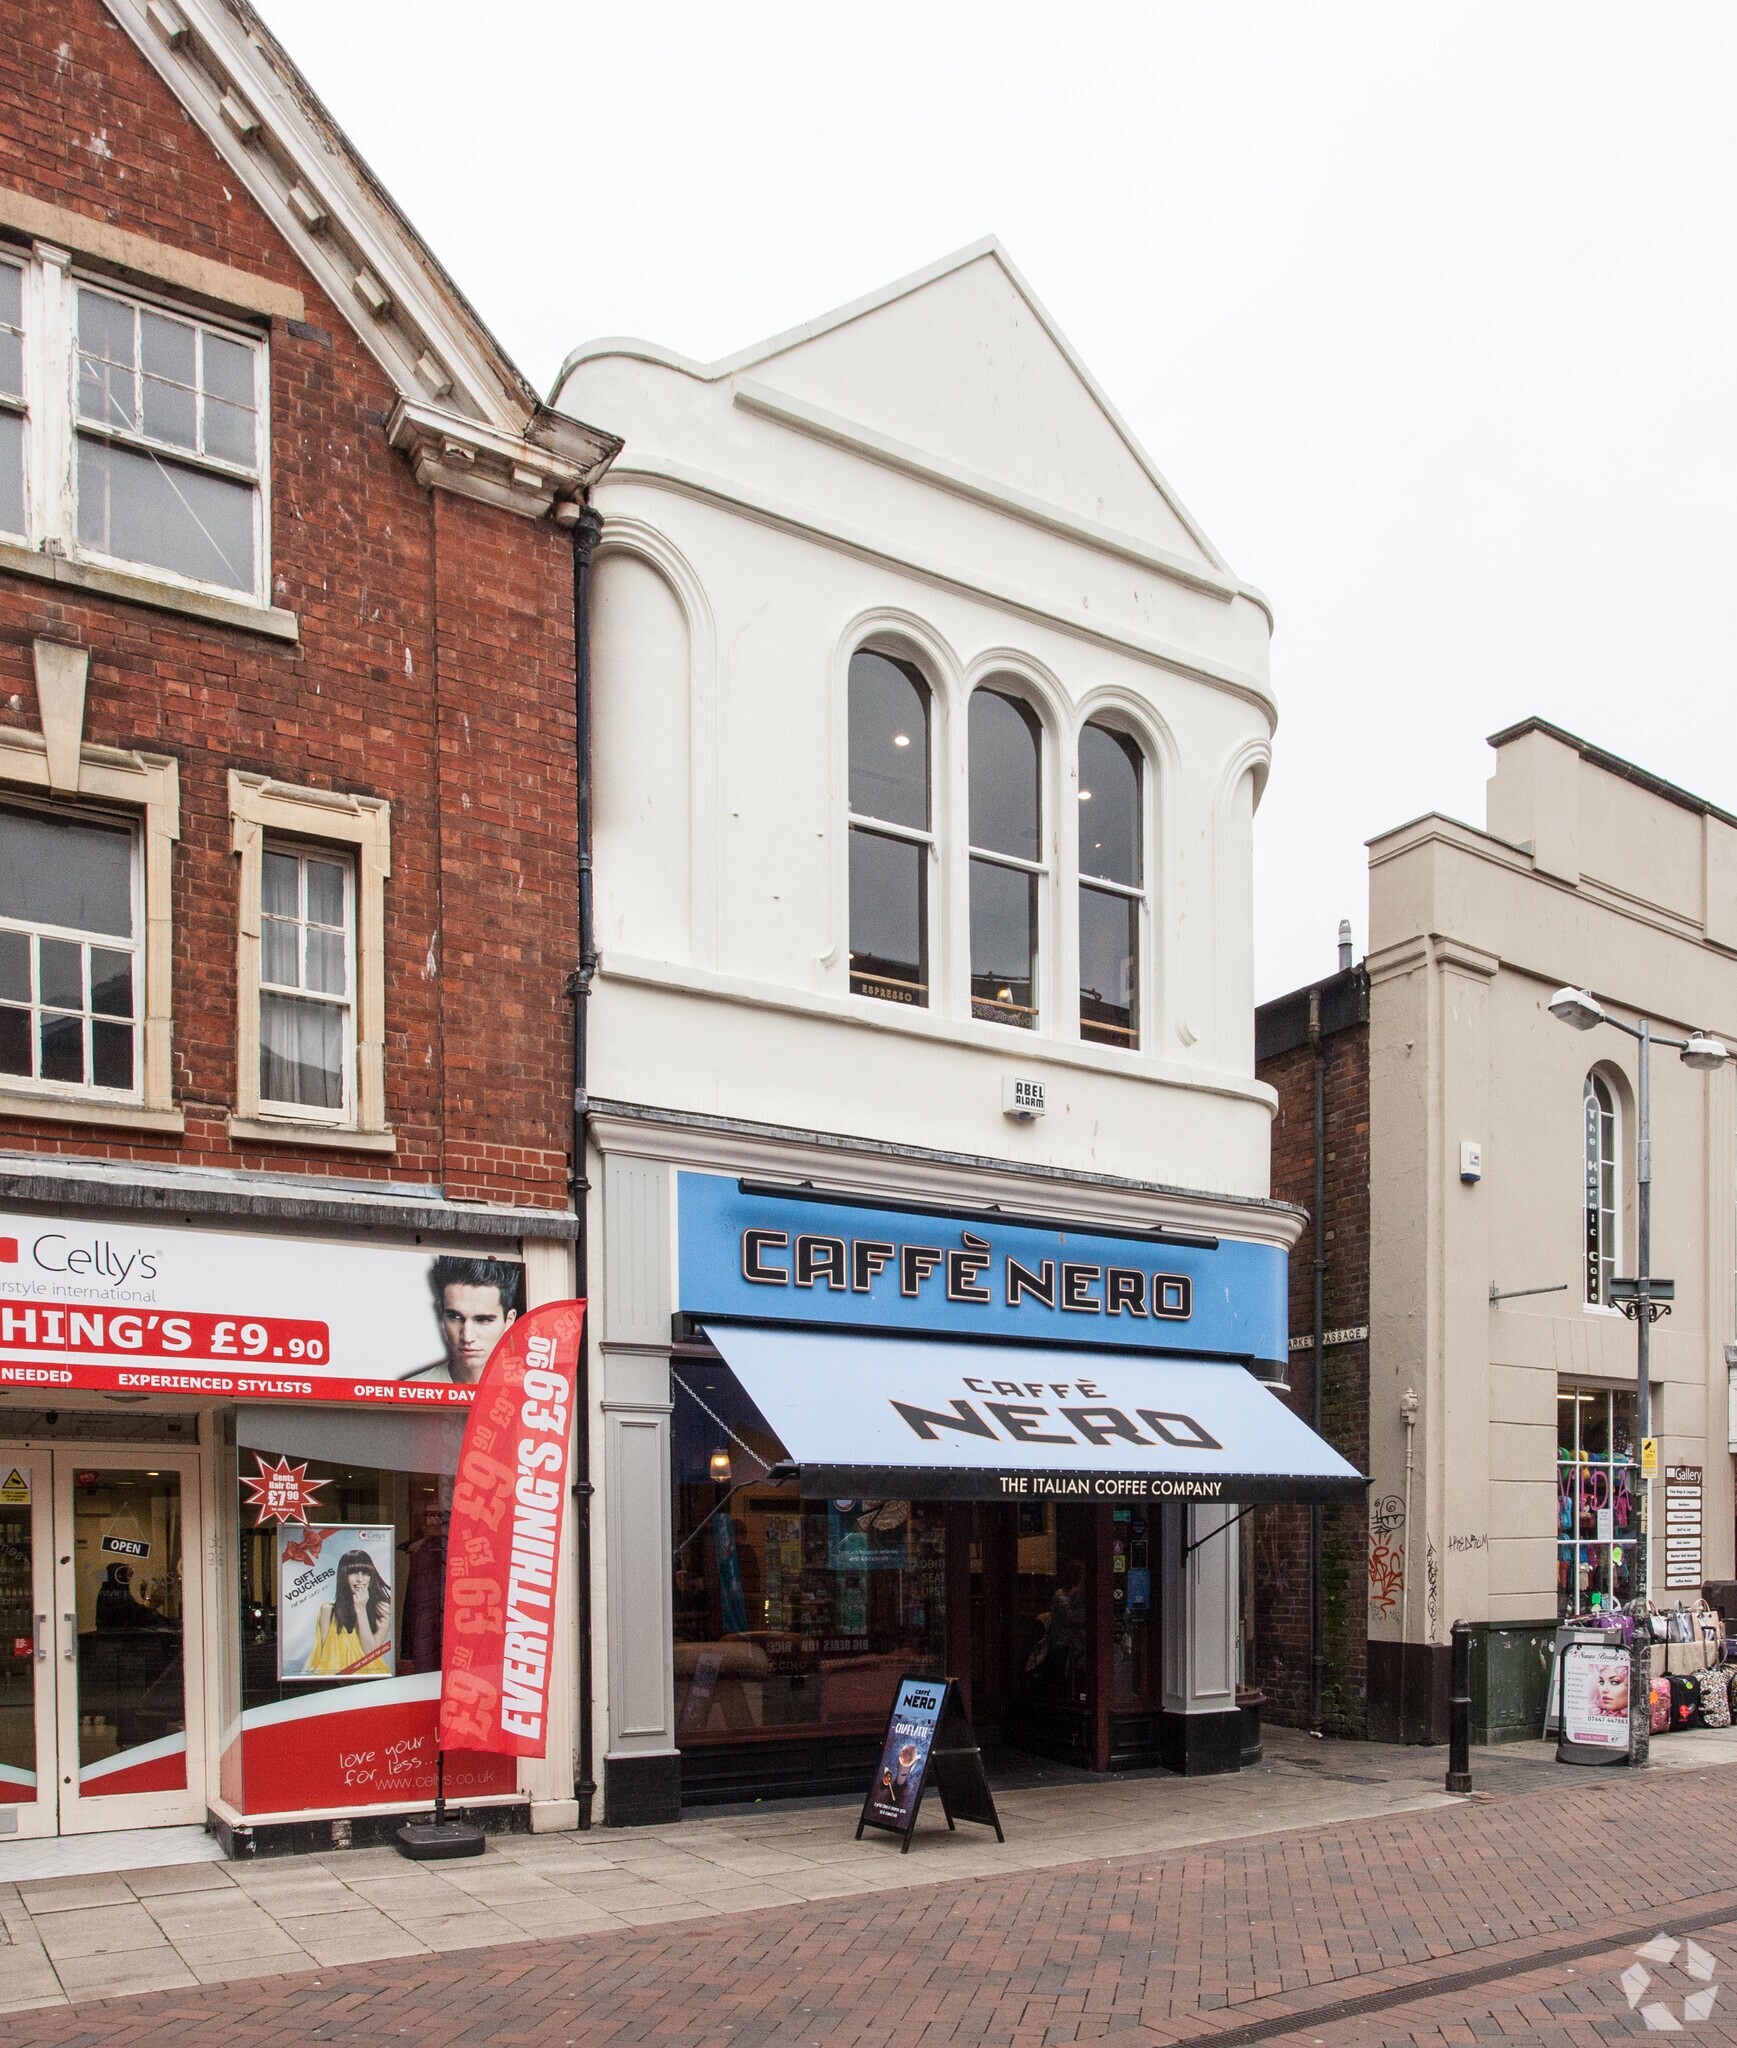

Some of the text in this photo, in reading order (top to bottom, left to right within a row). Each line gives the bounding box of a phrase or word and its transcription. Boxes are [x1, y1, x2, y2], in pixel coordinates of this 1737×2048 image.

[861, 984, 913, 1003] ESPRESSO
[1016, 1082, 1044, 1098] ABEL
[1016, 1095, 1044, 1108] ALARM
[33, 1234, 157, 1286] Celly's
[741, 1228, 1194, 1320] CAFFÈ NERO
[1588, 1252, 1599, 1302] Cafe
[52, 1282, 157, 1303] international
[1, 1307, 324, 1360] HING'S £9.90
[1, 1367, 73, 1383] NEEDED
[118, 1373, 312, 1395] EXPERIENCED STYLISTS
[353, 1384, 477, 1402] OPEN EVERY DAY
[962, 1377, 1107, 1399] CAFFÈ
[889, 1398, 1225, 1450] NERO
[269, 1481, 299, 1490] Hair Cut
[273, 1473, 295, 1482] Gents
[1675, 1467, 1702, 1484] Gallery
[1000, 1476, 1222, 1497] THE ITALIAN COFFEE COMPANY
[110, 1539, 141, 1555] OPEN
[285, 1567, 336, 1601] VOUCHERS
[294, 1569, 315, 1587] GIFT
[501, 1437, 563, 1740] EVERYTHING'S
[903, 1694, 936, 1710] NERO
[339, 1736, 424, 1769] love your
[344, 1769, 378, 1787] for
[375, 1770, 495, 1791] www.cells.co.uk
